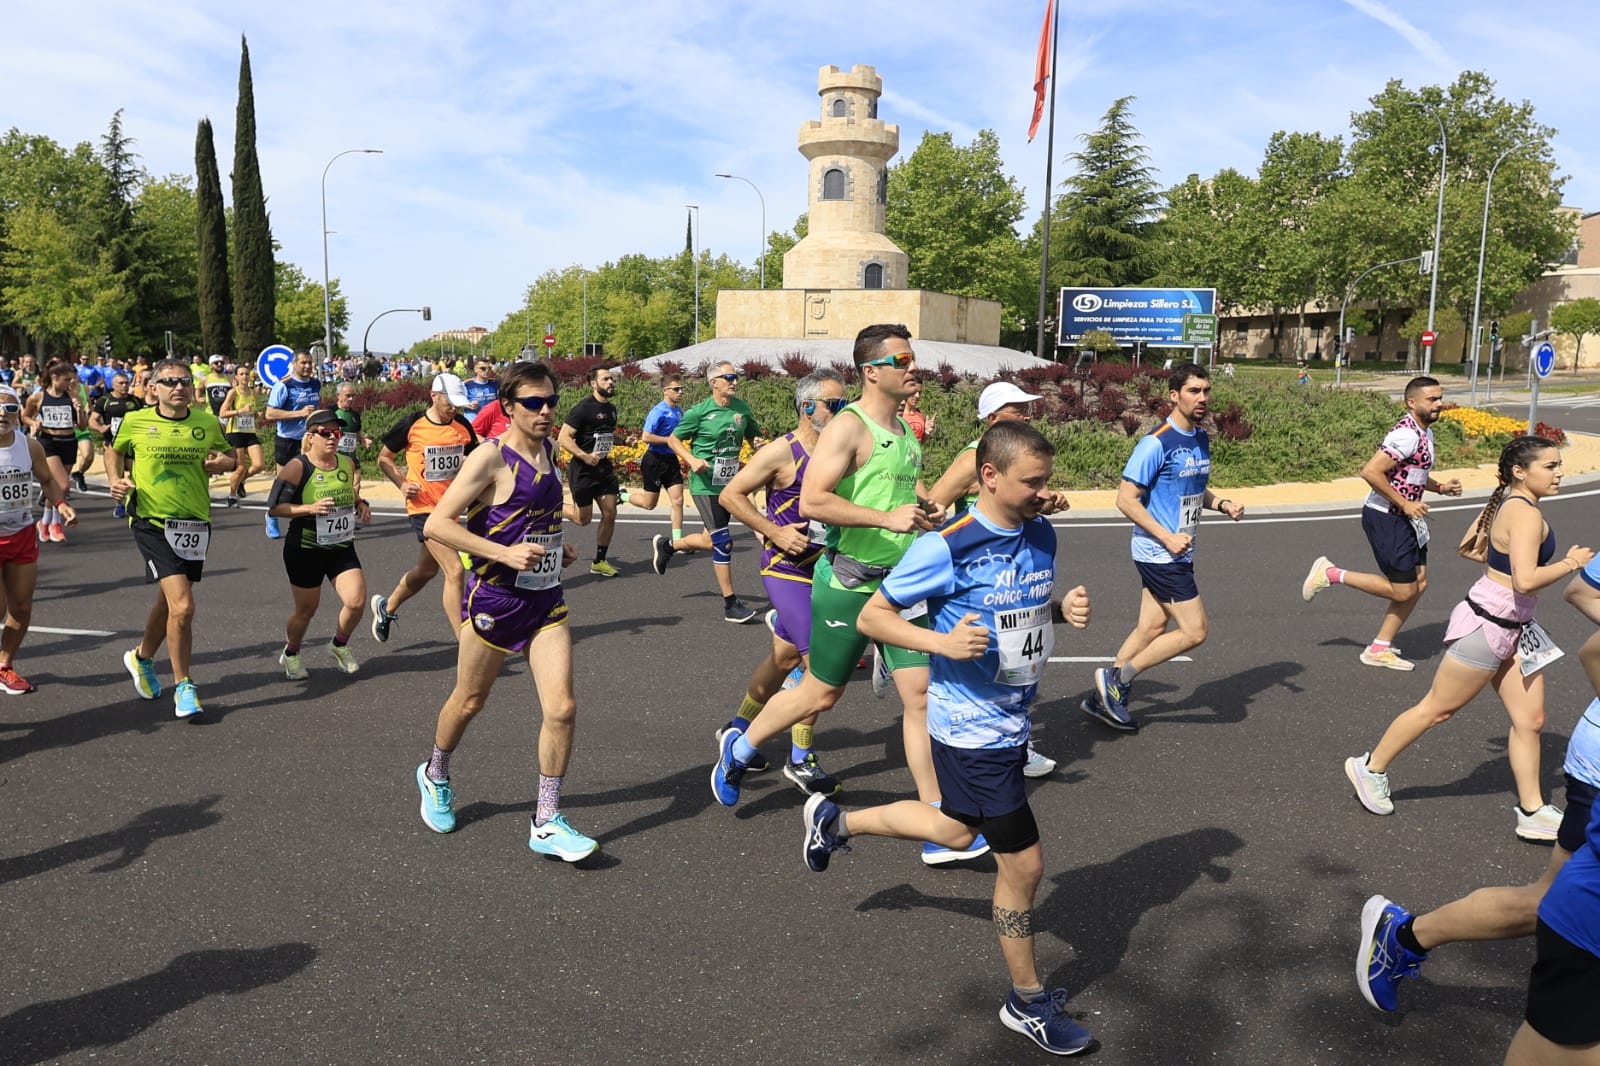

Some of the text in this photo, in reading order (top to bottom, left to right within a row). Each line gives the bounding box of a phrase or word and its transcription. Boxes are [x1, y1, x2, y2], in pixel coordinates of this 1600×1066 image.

[1103, 298, 1148, 310] Limpiezas
[1150, 298, 1179, 309] Sillero
[1181, 299, 1198, 309] S.L.
[47, 412, 70, 422] 1672
[430, 455, 460, 470] 1830
[2, 483, 29, 500] 685
[326, 516, 349, 533] 740
[174, 532, 200, 549] 739
[994, 570, 1017, 590] XII
[1000, 613, 1017, 630] XII
[1021, 629, 1044, 660] 44
